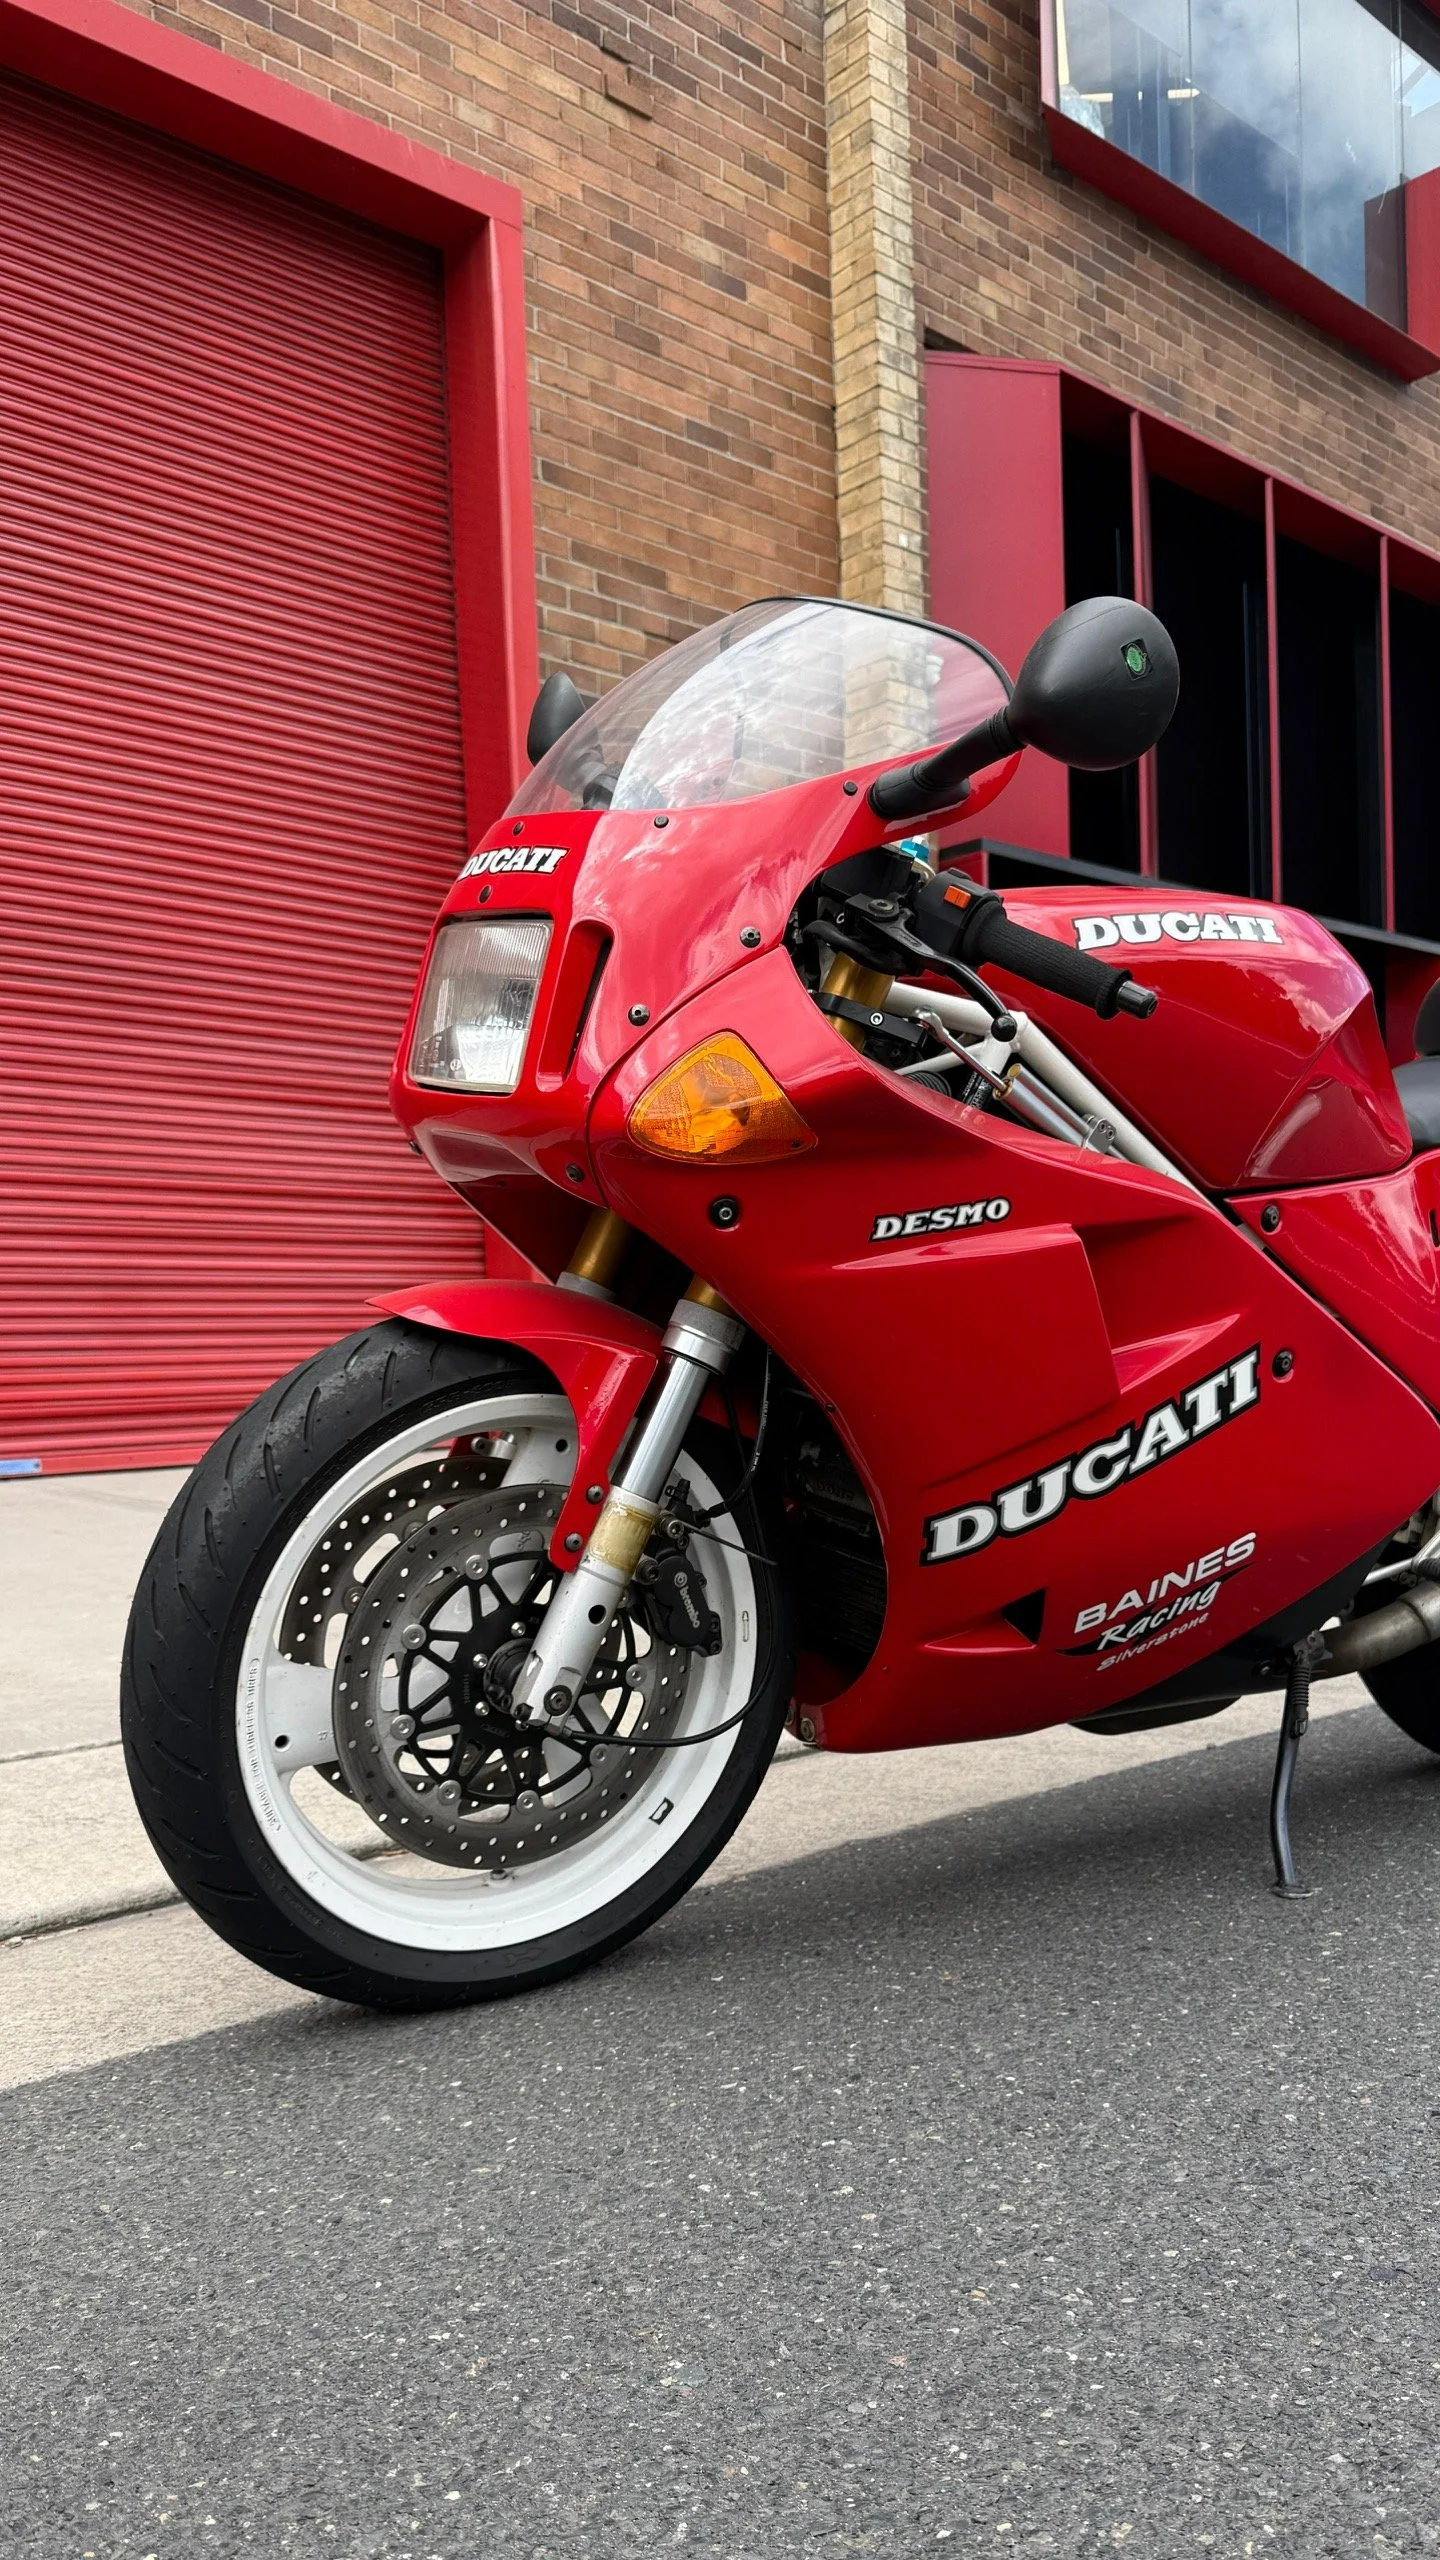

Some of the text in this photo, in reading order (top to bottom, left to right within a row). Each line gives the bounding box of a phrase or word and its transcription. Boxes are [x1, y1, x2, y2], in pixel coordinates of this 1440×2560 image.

[458, 847, 568, 880] DUCATI
[1074, 911, 1283, 950] DUCATI
[872, 1198, 1010, 1240] DESMO
[926, 1350, 1260, 1561] DUCATI
[680, 1585, 700, 1627] brembo
[1074, 1532, 1256, 1634] BAINES
[1097, 1581, 1222, 1651] Racing
[1097, 1613, 1209, 1671] Silverstone
